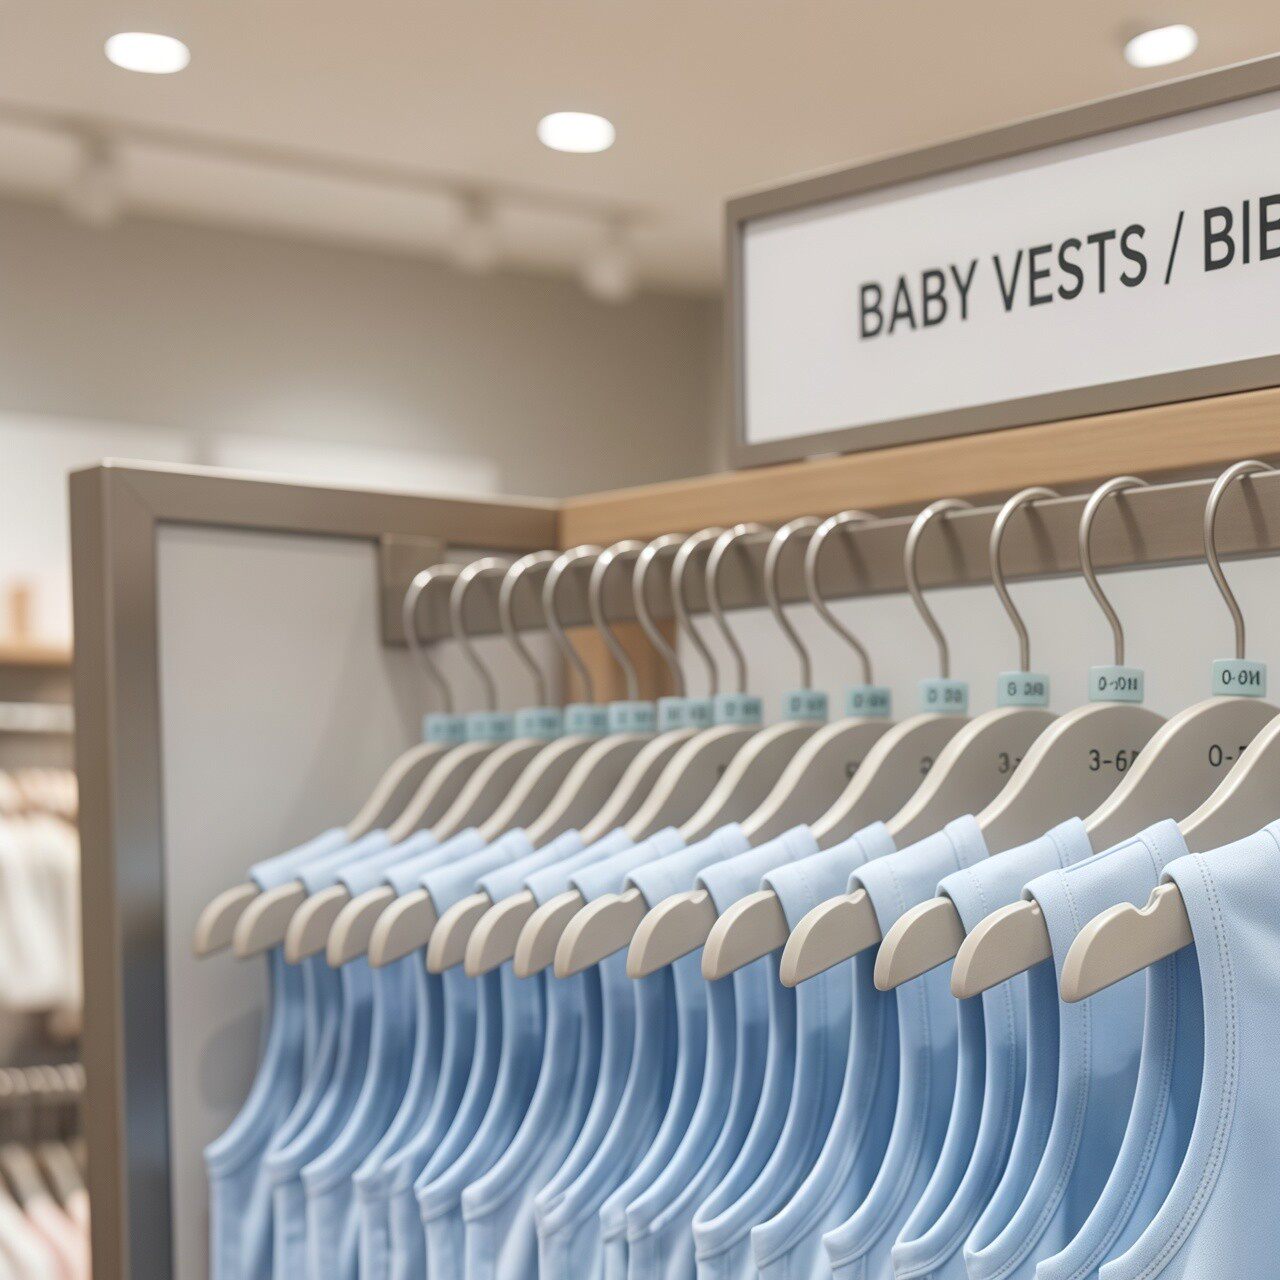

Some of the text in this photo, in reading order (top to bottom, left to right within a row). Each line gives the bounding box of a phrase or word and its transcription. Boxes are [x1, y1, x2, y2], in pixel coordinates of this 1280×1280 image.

[858, 258, 978, 339] BABY
[994, 223, 1148, 313] VESTS
[1164, 210, 1185, 286] /
[1208, 744, 1248, 767] 0-
